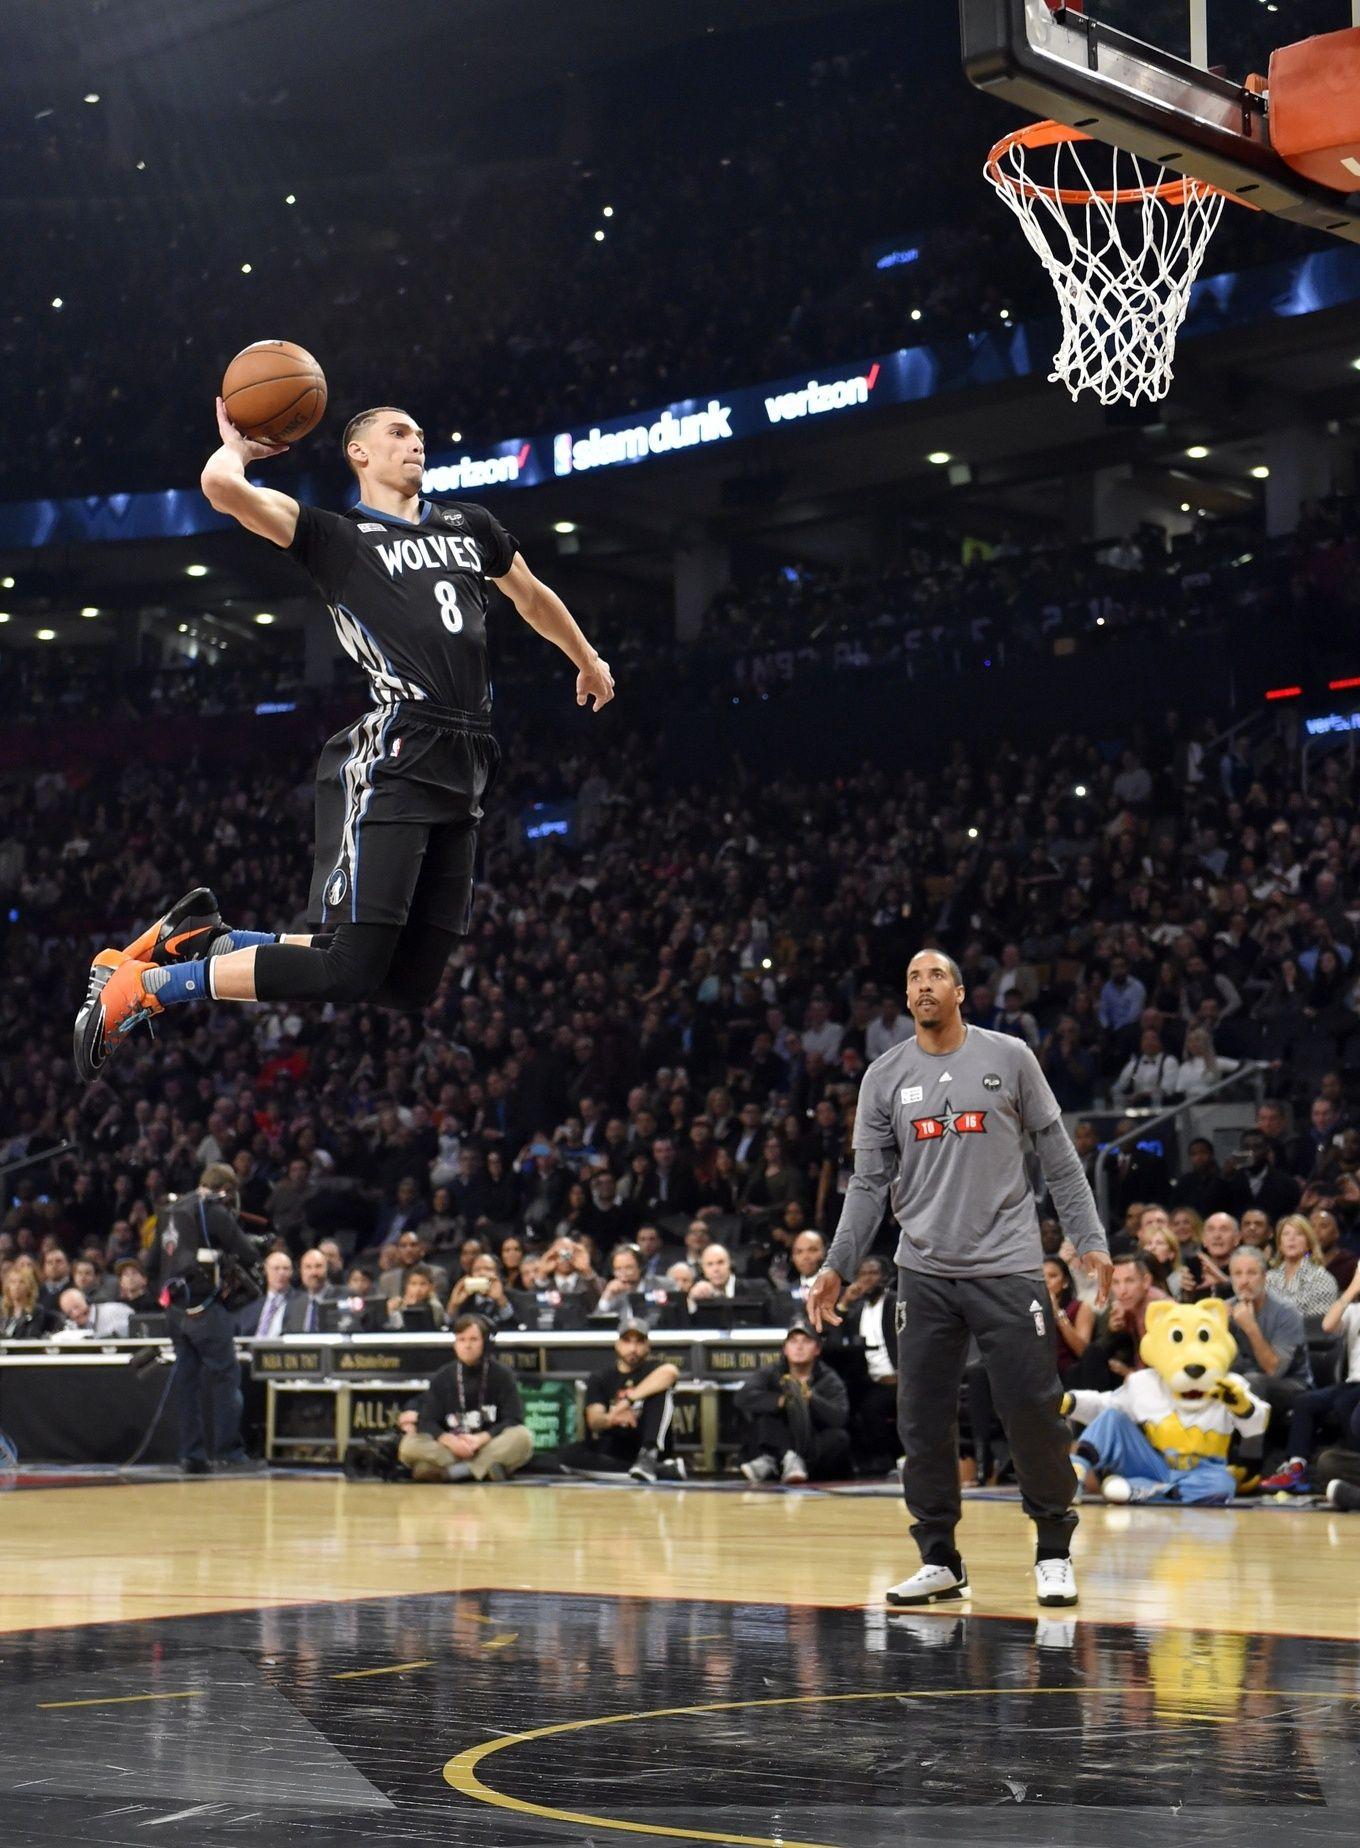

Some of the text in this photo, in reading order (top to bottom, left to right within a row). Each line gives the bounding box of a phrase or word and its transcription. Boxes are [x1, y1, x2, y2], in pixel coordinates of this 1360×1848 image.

[765, 375, 868, 423] verizon
[421, 453, 519, 494] verizon
[374, 535, 482, 578] WOLVES
[434, 580, 464, 634] 8
[965, 1115, 977, 1128] 16
